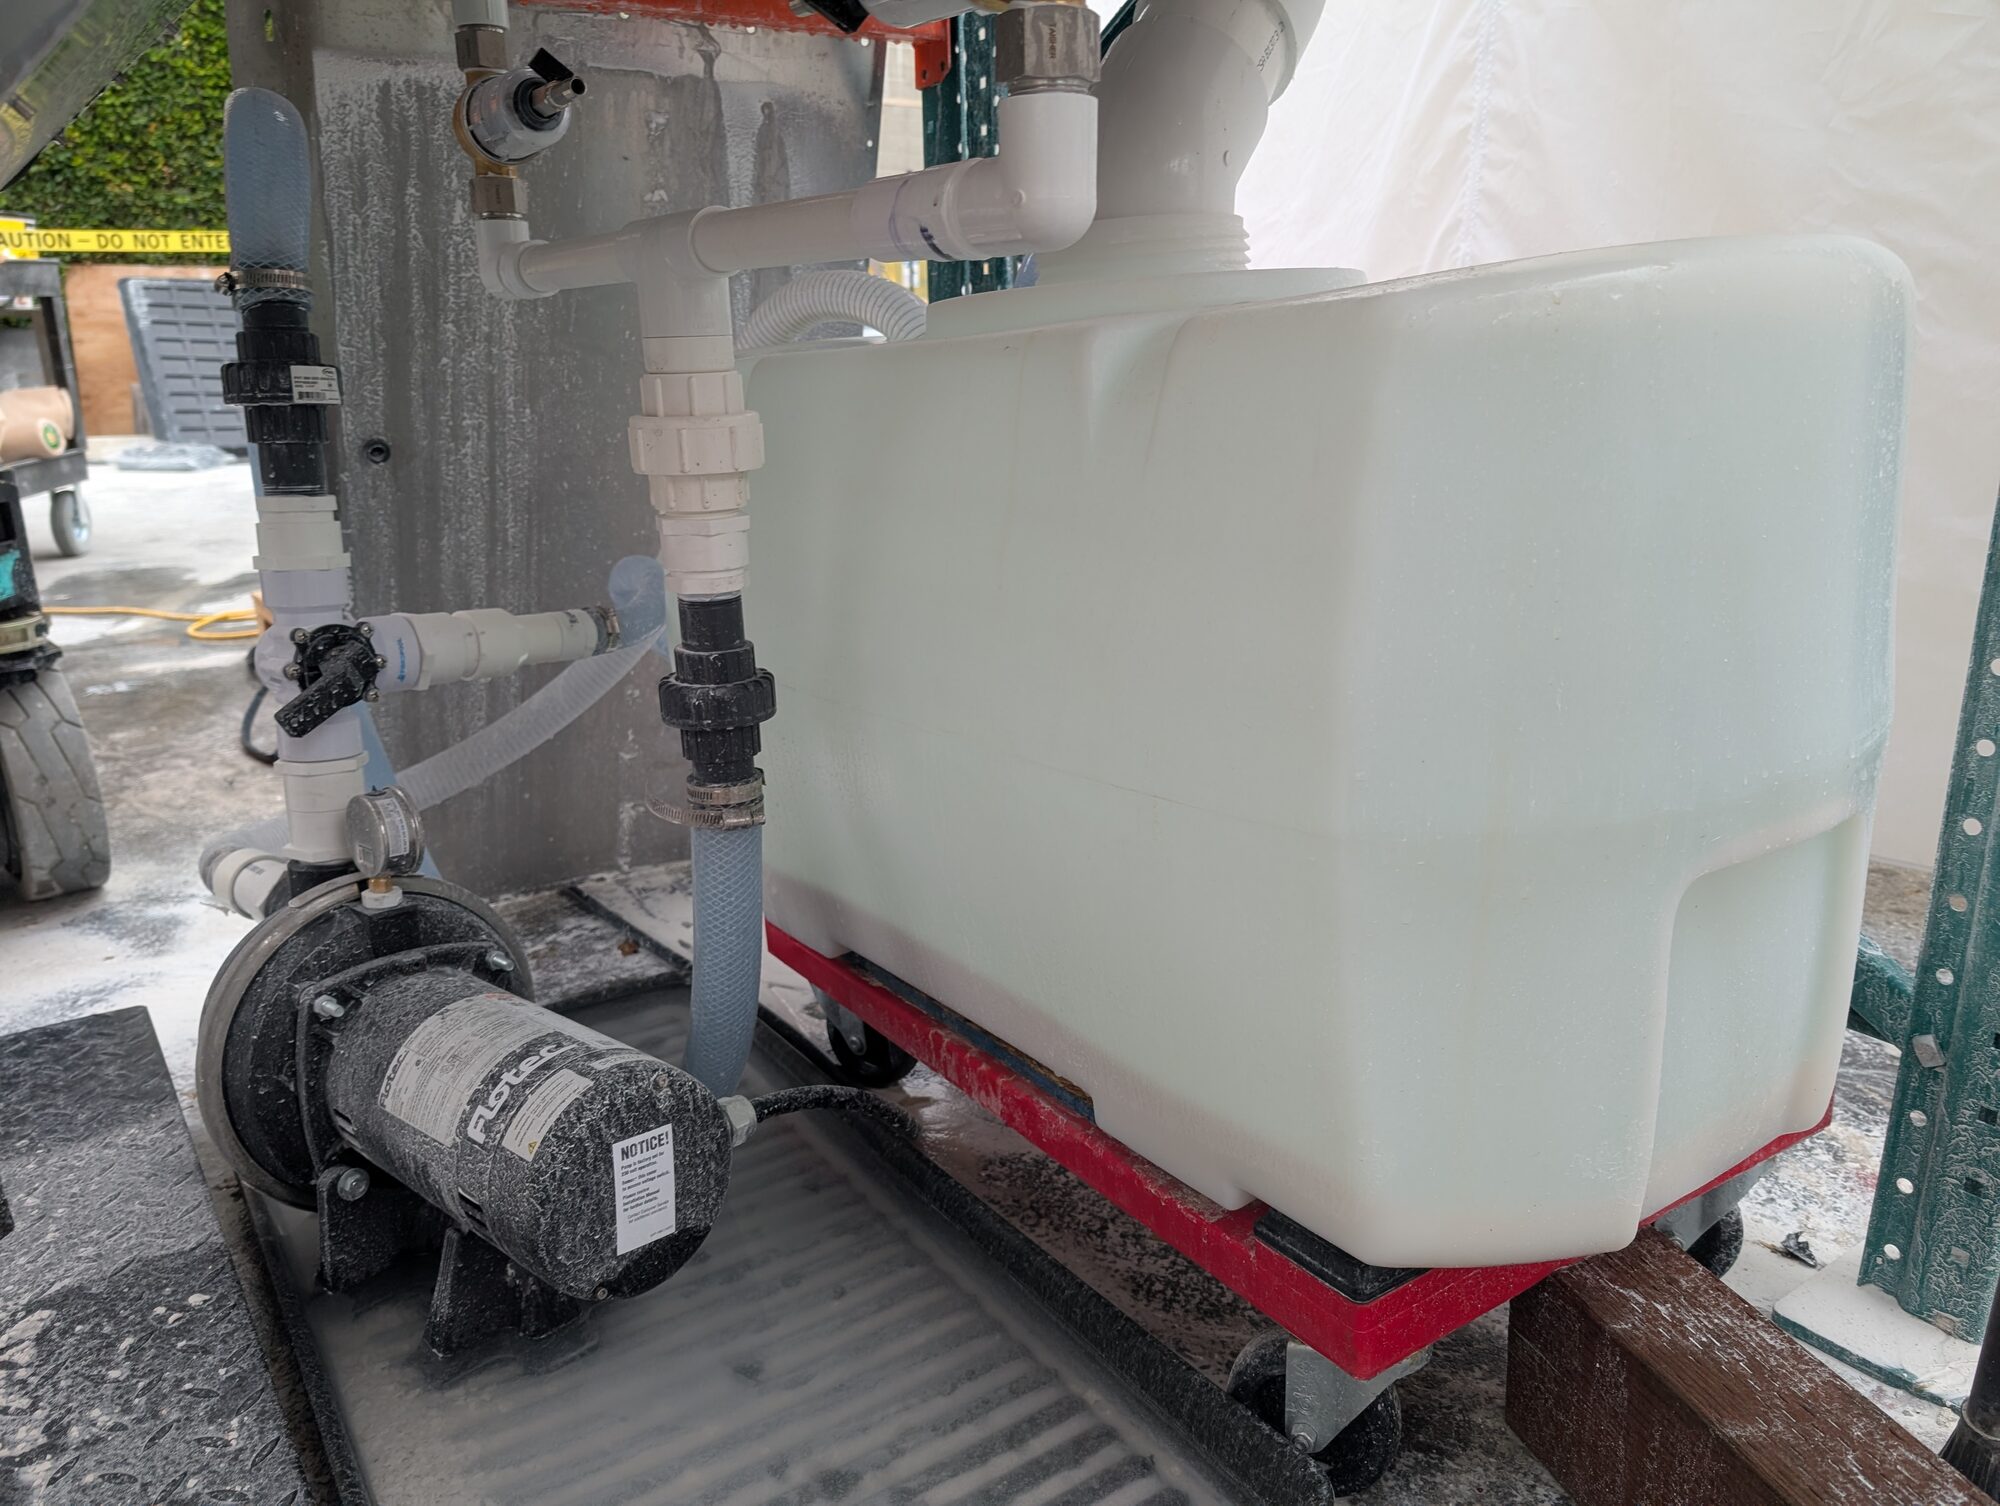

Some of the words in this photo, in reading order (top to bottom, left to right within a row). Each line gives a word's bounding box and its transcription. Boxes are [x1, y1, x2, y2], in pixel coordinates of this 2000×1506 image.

[0, 232, 72, 249] AUTION
[97, 234, 124, 250] DO
[133, 234, 171, 250] NOT
[181, 234, 229, 250] ENTE
[621, 1131, 670, 1161] NOTICE!
